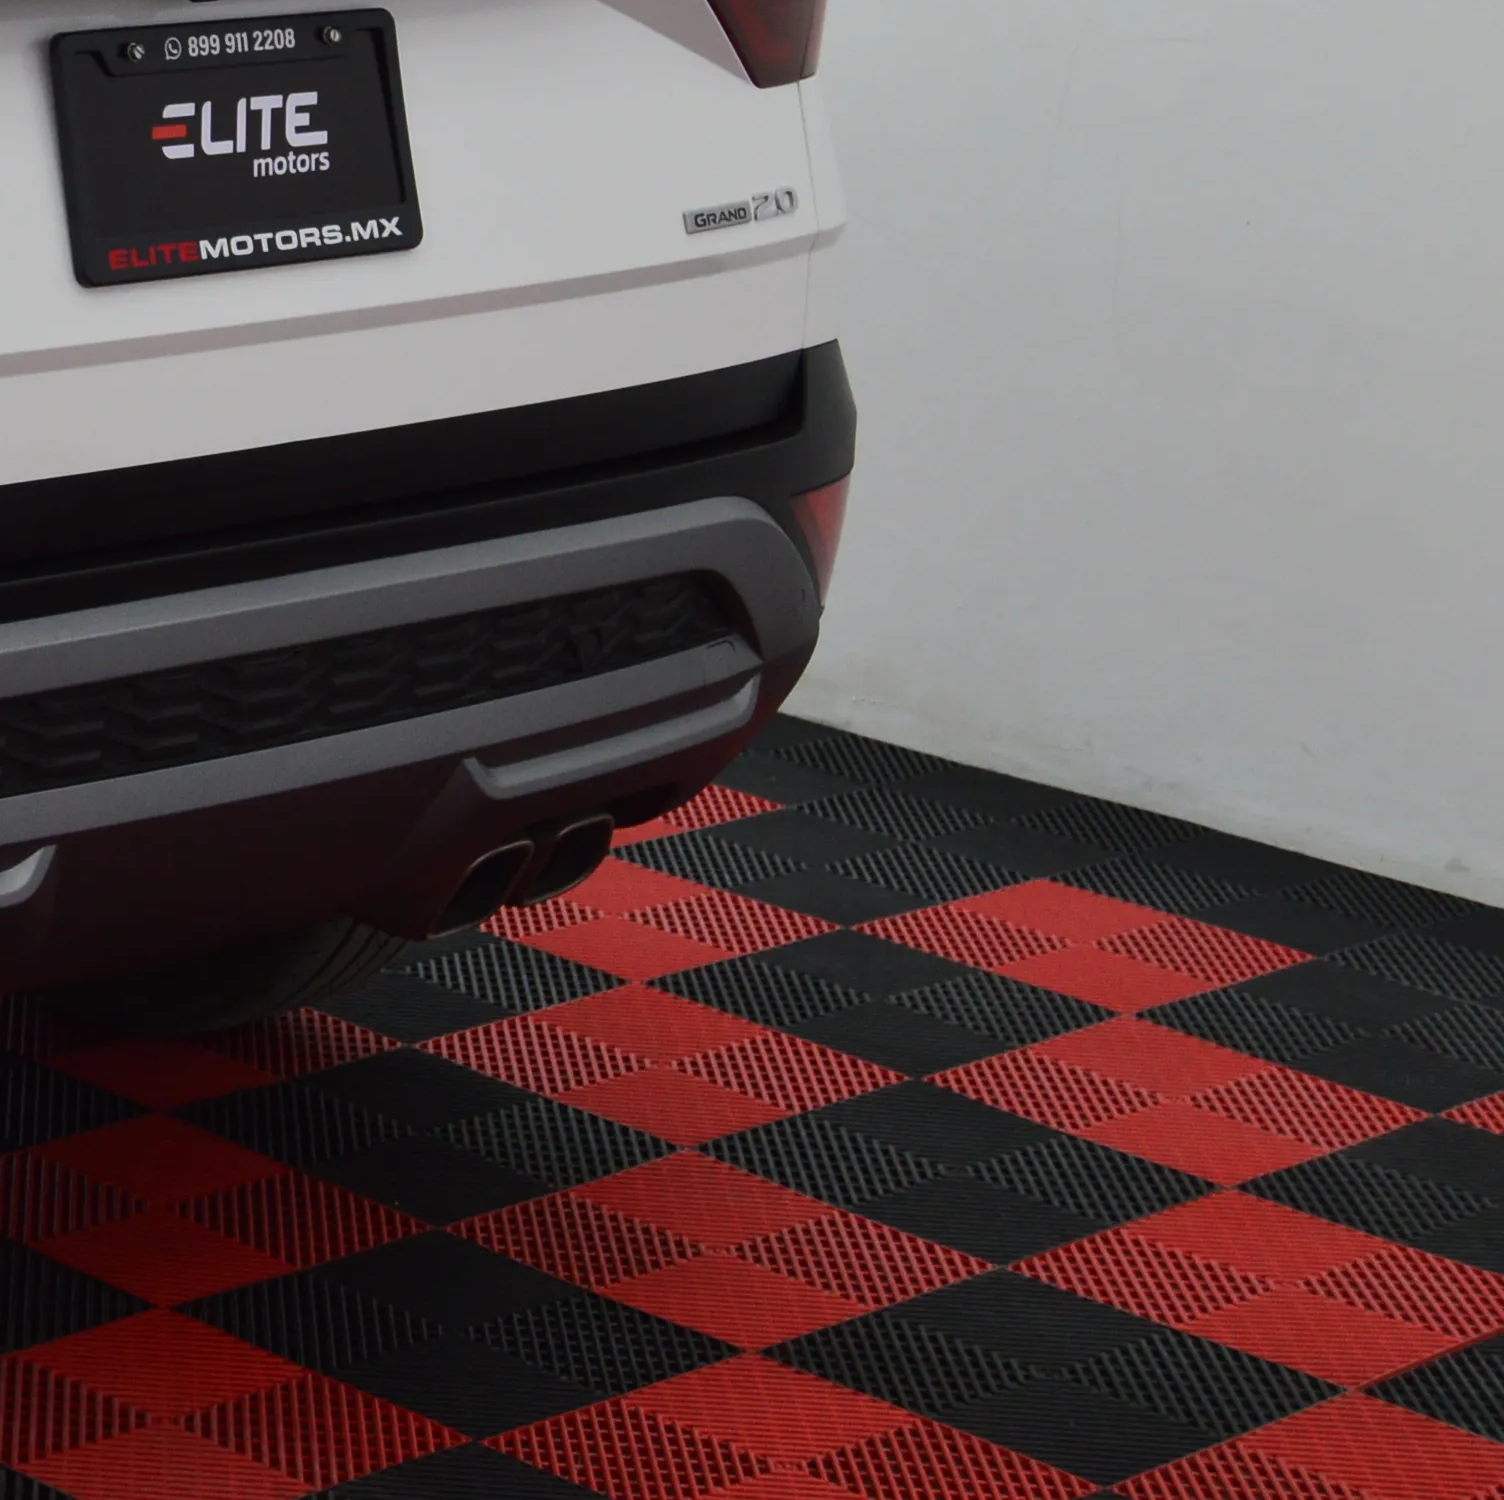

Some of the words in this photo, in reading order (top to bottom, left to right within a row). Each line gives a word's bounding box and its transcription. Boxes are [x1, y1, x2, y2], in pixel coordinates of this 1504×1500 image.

[187, 34, 220, 57] 899
[225, 31, 249, 54] 911
[253, 28, 296, 51] 2208
[151, 91, 328, 160] ELITE
[253, 151, 330, 178] motors
[108, 216, 403, 271] ELITEMOTORS.MX
